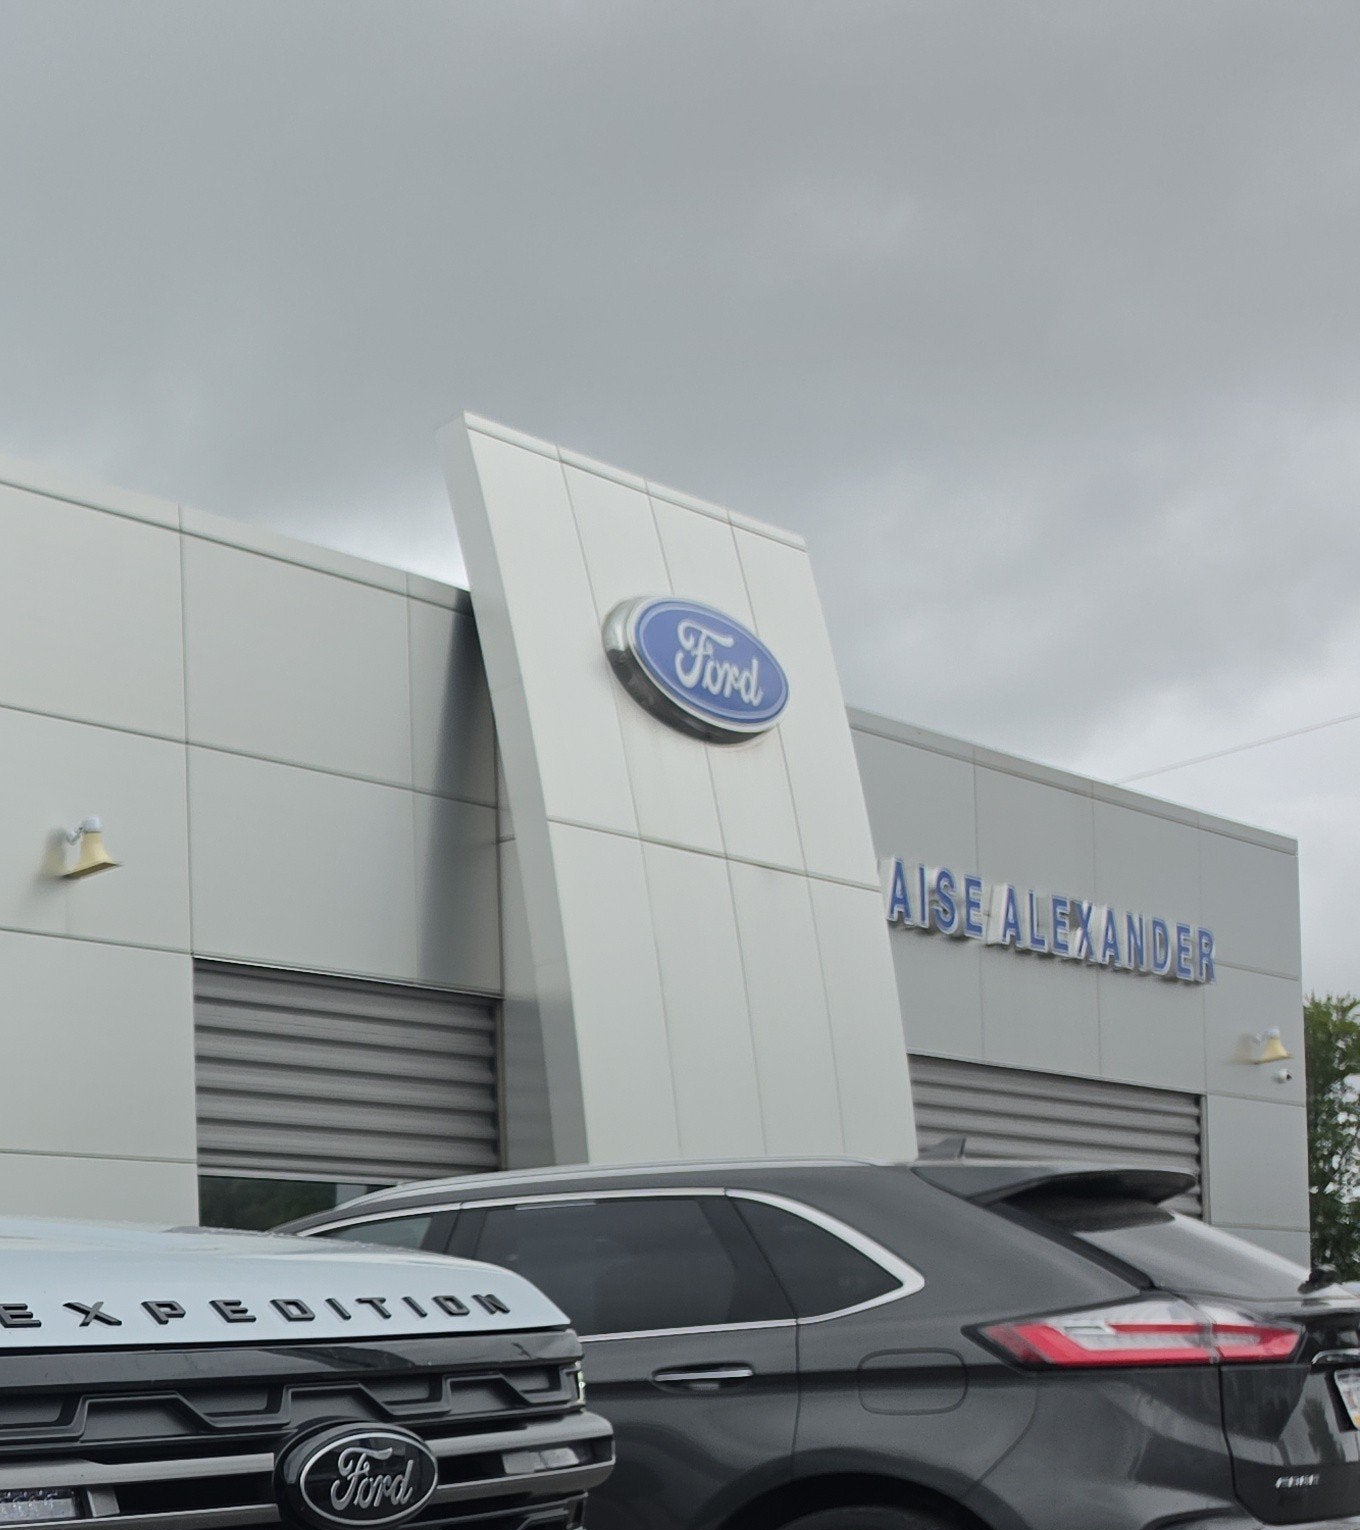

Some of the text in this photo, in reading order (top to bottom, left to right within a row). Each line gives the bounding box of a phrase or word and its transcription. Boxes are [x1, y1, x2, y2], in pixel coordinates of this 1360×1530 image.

[675, 620, 764, 706] Ford
[995, 882, 1216, 983] ALEXANDER
[331, 1446, 414, 1510] Ford
